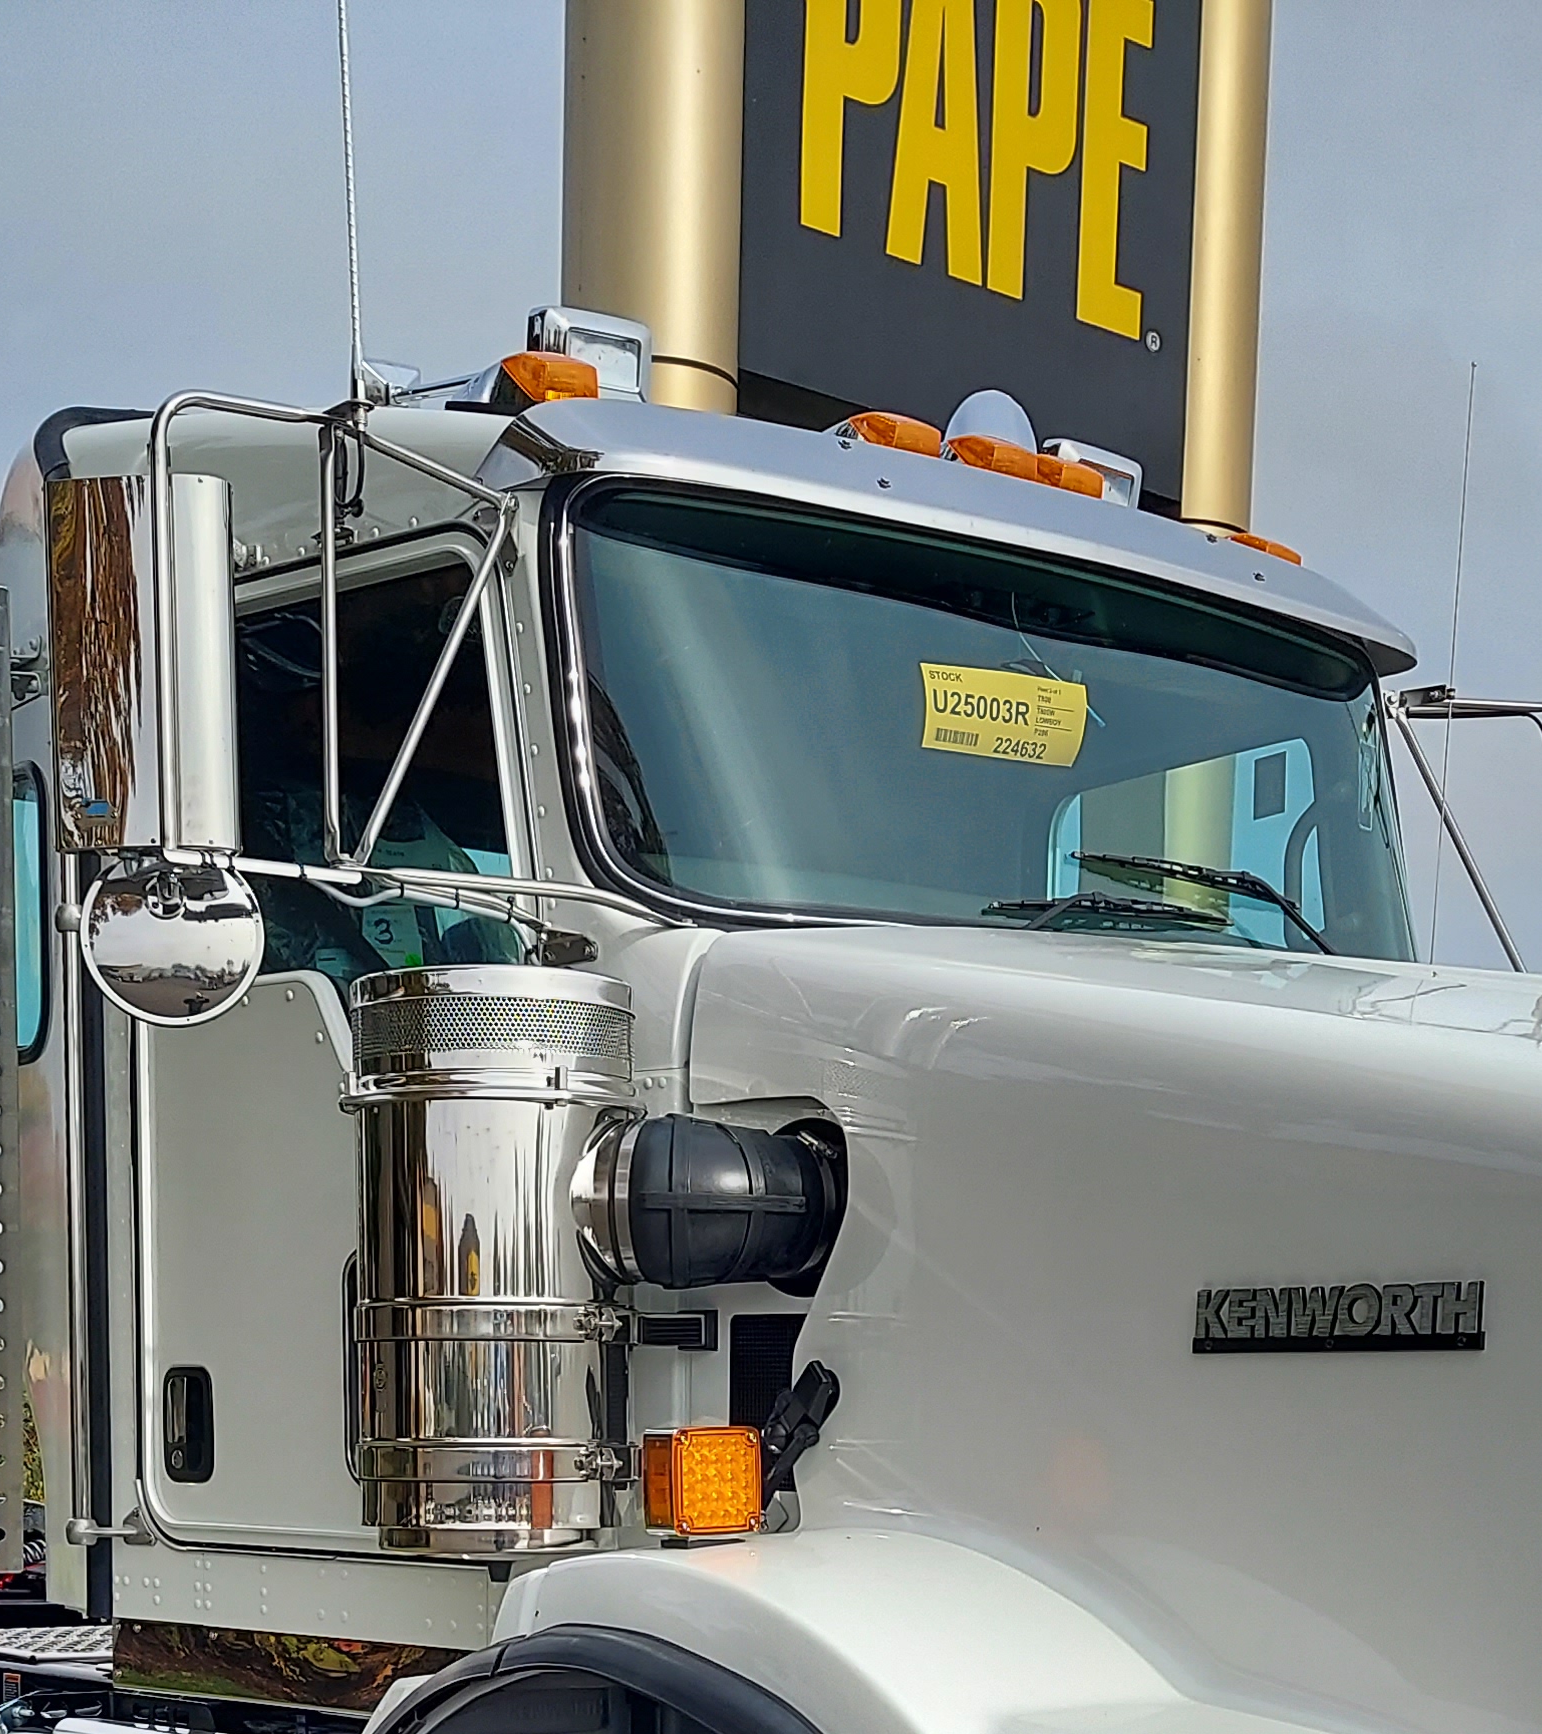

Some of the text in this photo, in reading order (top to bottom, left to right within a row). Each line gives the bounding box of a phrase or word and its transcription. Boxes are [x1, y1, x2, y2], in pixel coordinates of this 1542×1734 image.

[928, 670, 963, 683] STOCK
[933, 688, 1030, 727] U25003R
[993, 736, 1047, 760] 224632
[374, 918, 394, 945] 3
[1194, 1280, 1486, 1340] KENWORTH
